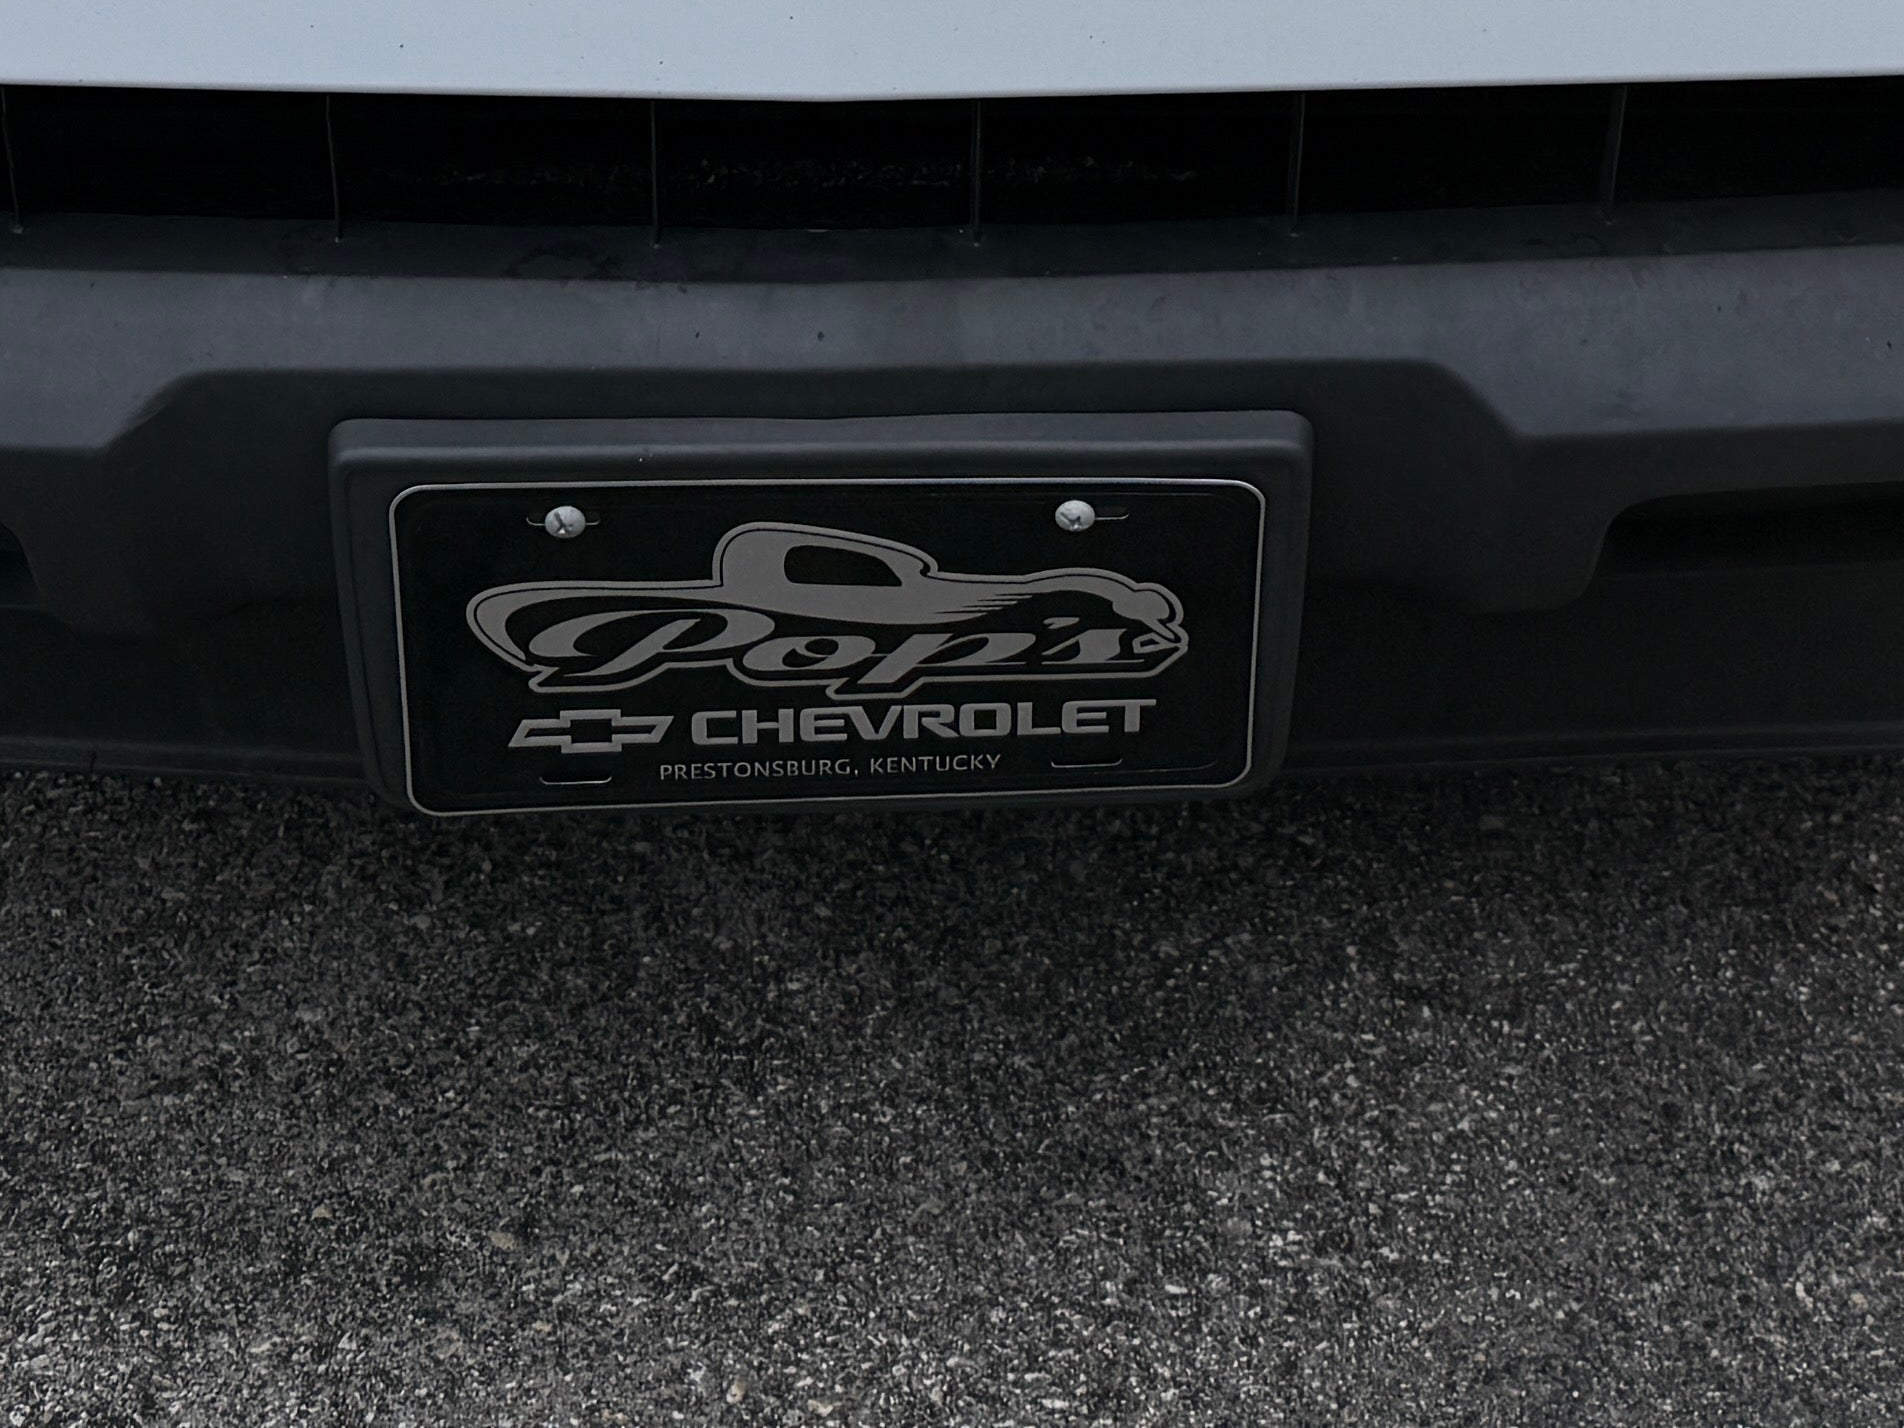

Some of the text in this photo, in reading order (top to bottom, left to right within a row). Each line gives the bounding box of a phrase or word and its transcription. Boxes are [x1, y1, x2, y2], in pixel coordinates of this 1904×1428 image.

[528, 608, 1145, 685] Pop's
[691, 699, 1157, 745] CHEVROLET
[659, 753, 1001, 780] PRESTONSBURG, KENTUCKY
